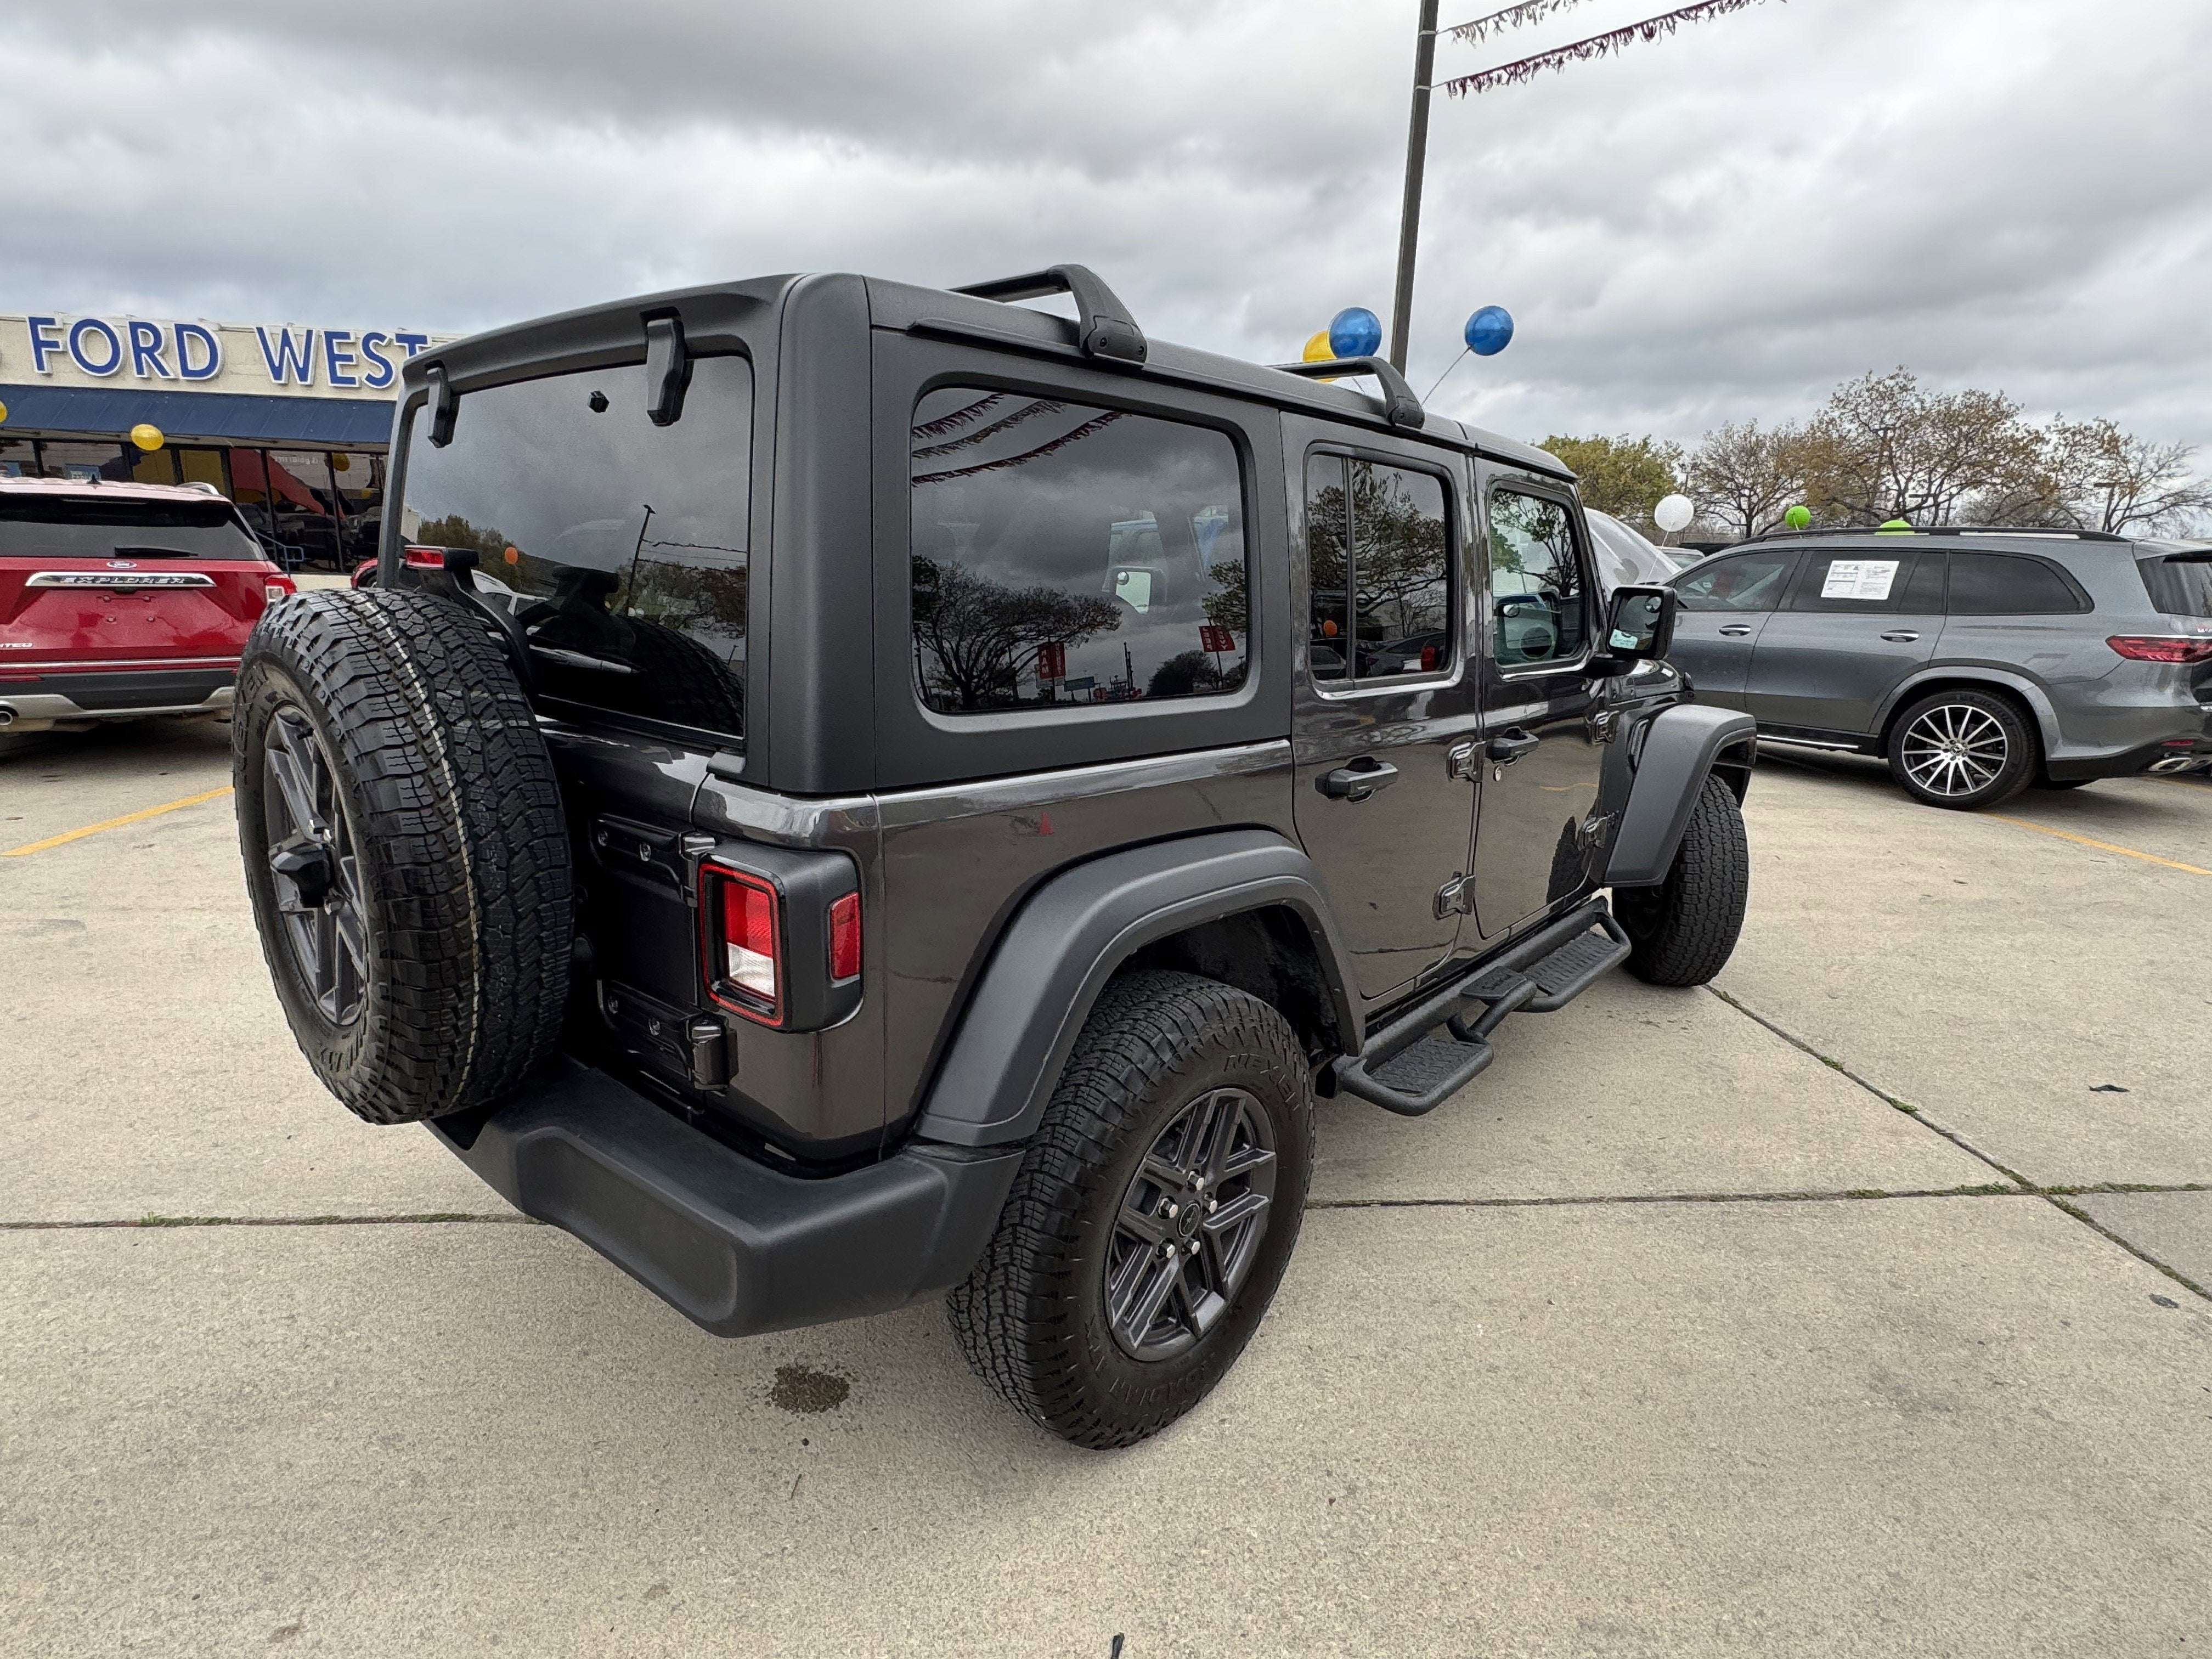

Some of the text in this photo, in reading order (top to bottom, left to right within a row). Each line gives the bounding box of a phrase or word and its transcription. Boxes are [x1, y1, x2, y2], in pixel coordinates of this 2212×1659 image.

[27, 314, 432, 388] FORD WEST
[1223, 1052, 1301, 1121] NEXEN
